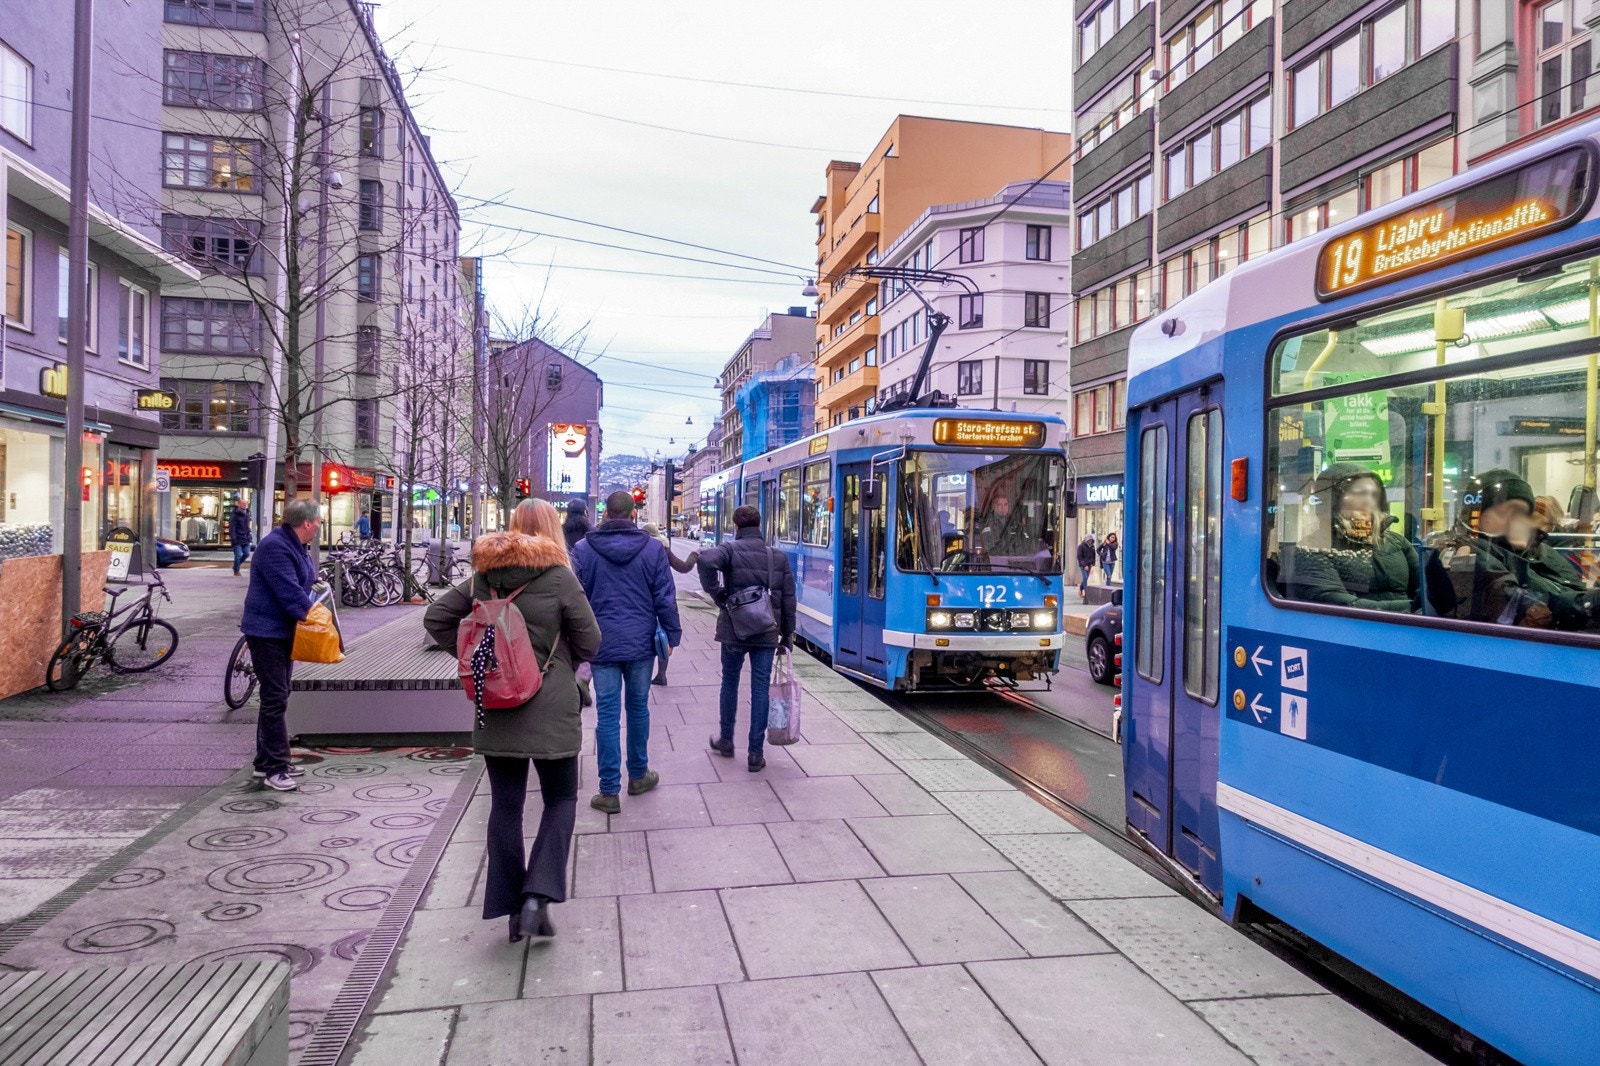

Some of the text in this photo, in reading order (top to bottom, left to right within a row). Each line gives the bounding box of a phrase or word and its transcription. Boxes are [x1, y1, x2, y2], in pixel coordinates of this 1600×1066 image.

[1373, 202, 1547, 274] Briskeby-Nationalth.
[1377, 212, 1443, 252] Ljabru
[1330, 238, 1363, 289] 19
[140, 392, 173, 408] nille
[1343, 393, 1373, 408] Takk
[957, 423, 1036, 435] Storo-Grefsen st.
[108, 544, 130, 553] SALG
[976, 584, 1007, 602] 122
[1287, 663, 1301, 673] KORT
